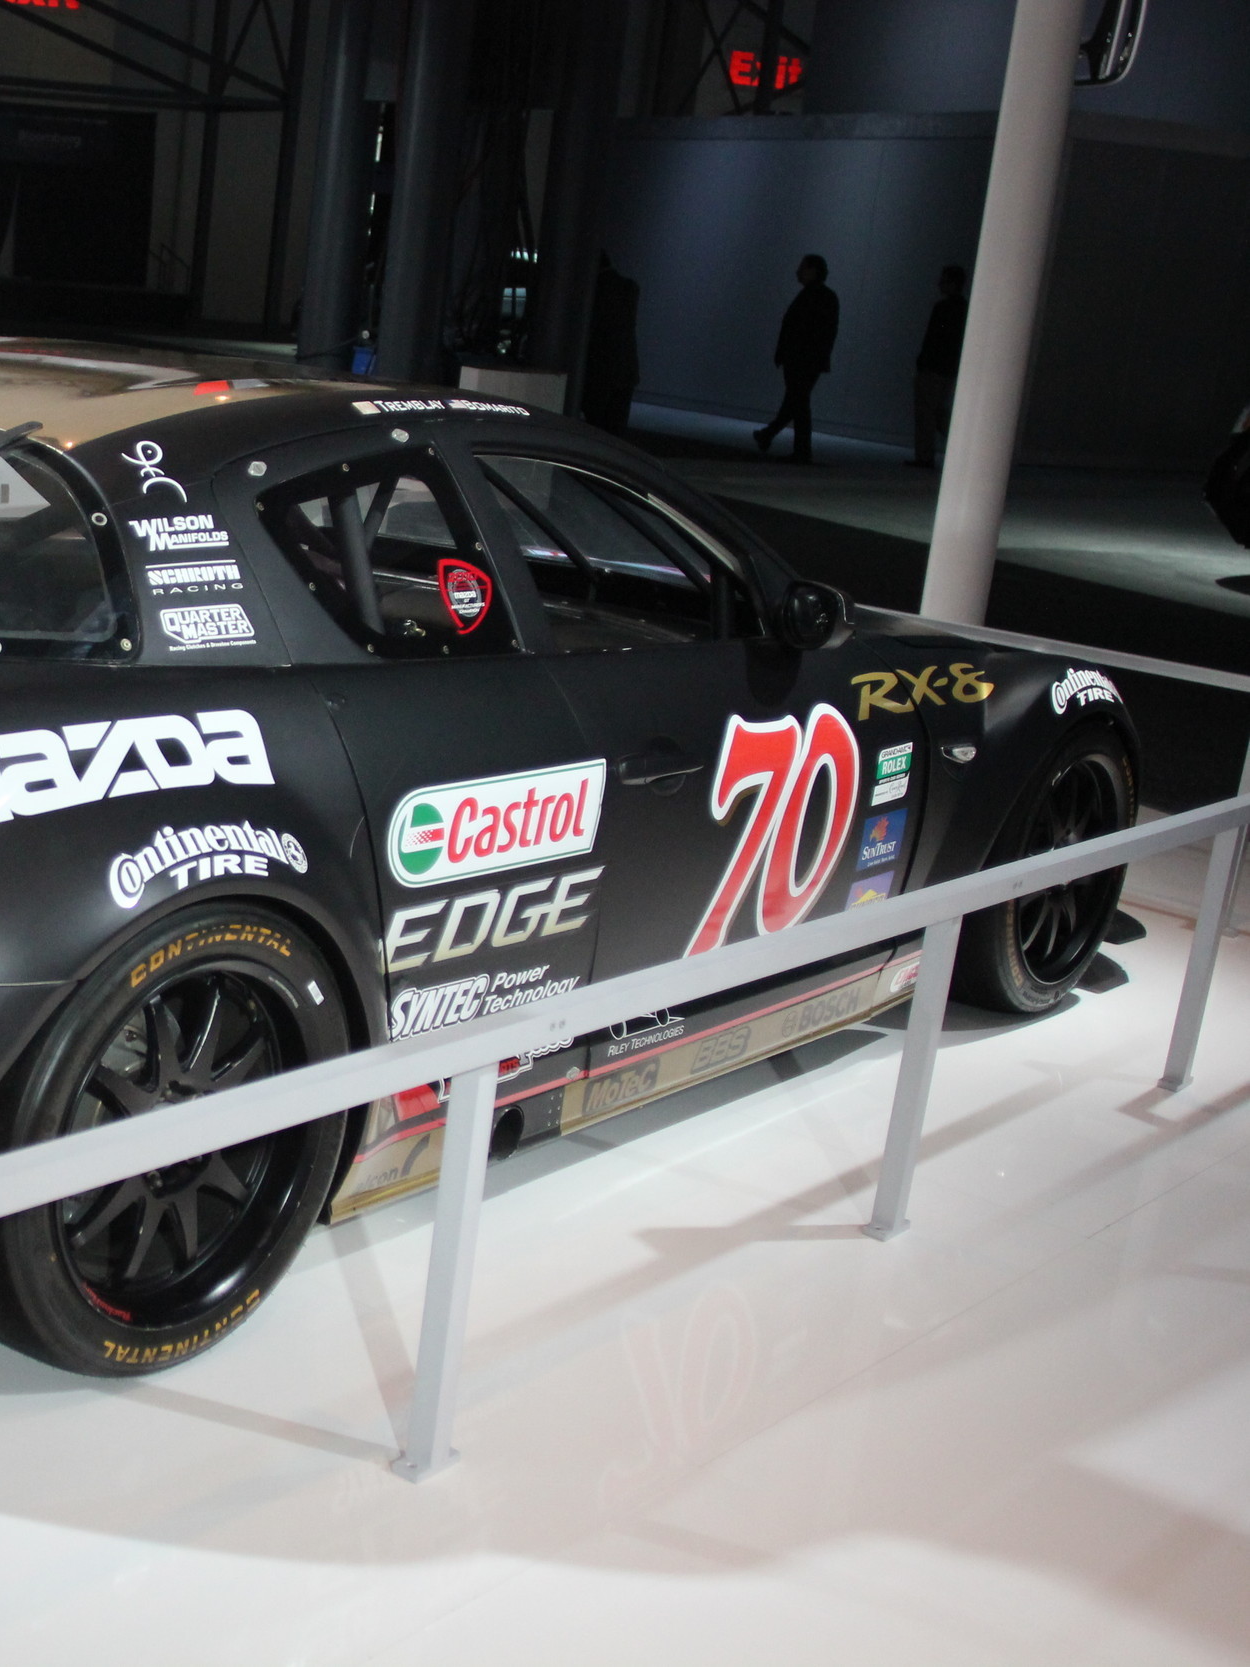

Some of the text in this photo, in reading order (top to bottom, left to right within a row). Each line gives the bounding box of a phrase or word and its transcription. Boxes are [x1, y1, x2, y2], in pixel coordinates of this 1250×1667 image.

[464, 400, 530, 416] BOMARITO
[129, 514, 214, 537] WILSON
[150, 531, 228, 551] MANIFOLDS
[147, 564, 241, 586] SCHROTH
[152, 582, 244, 595] RACING
[163, 607, 242, 632] QUARTER
[181, 620, 249, 640] MASTER
[851, 662, 995, 721] RX-8
[1077, 687, 1114, 707] TIRE
[881, 755, 907, 776] ROLEX
[447, 777, 589, 864] Castrol
[683, 702, 861, 958] 70
[109, 820, 290, 909] Continental
[169, 853, 269, 890] TIRE
[378, 865, 606, 974] EDGE
[130, 924, 293, 988] CONTINENTAL
[390, 963, 550, 1041] SYNTEC Power
[481, 975, 580, 1016] Technology
[799, 986, 861, 1032] BOSCH
[607, 1025, 685, 1057] RILEY TECHNOLOGIES
